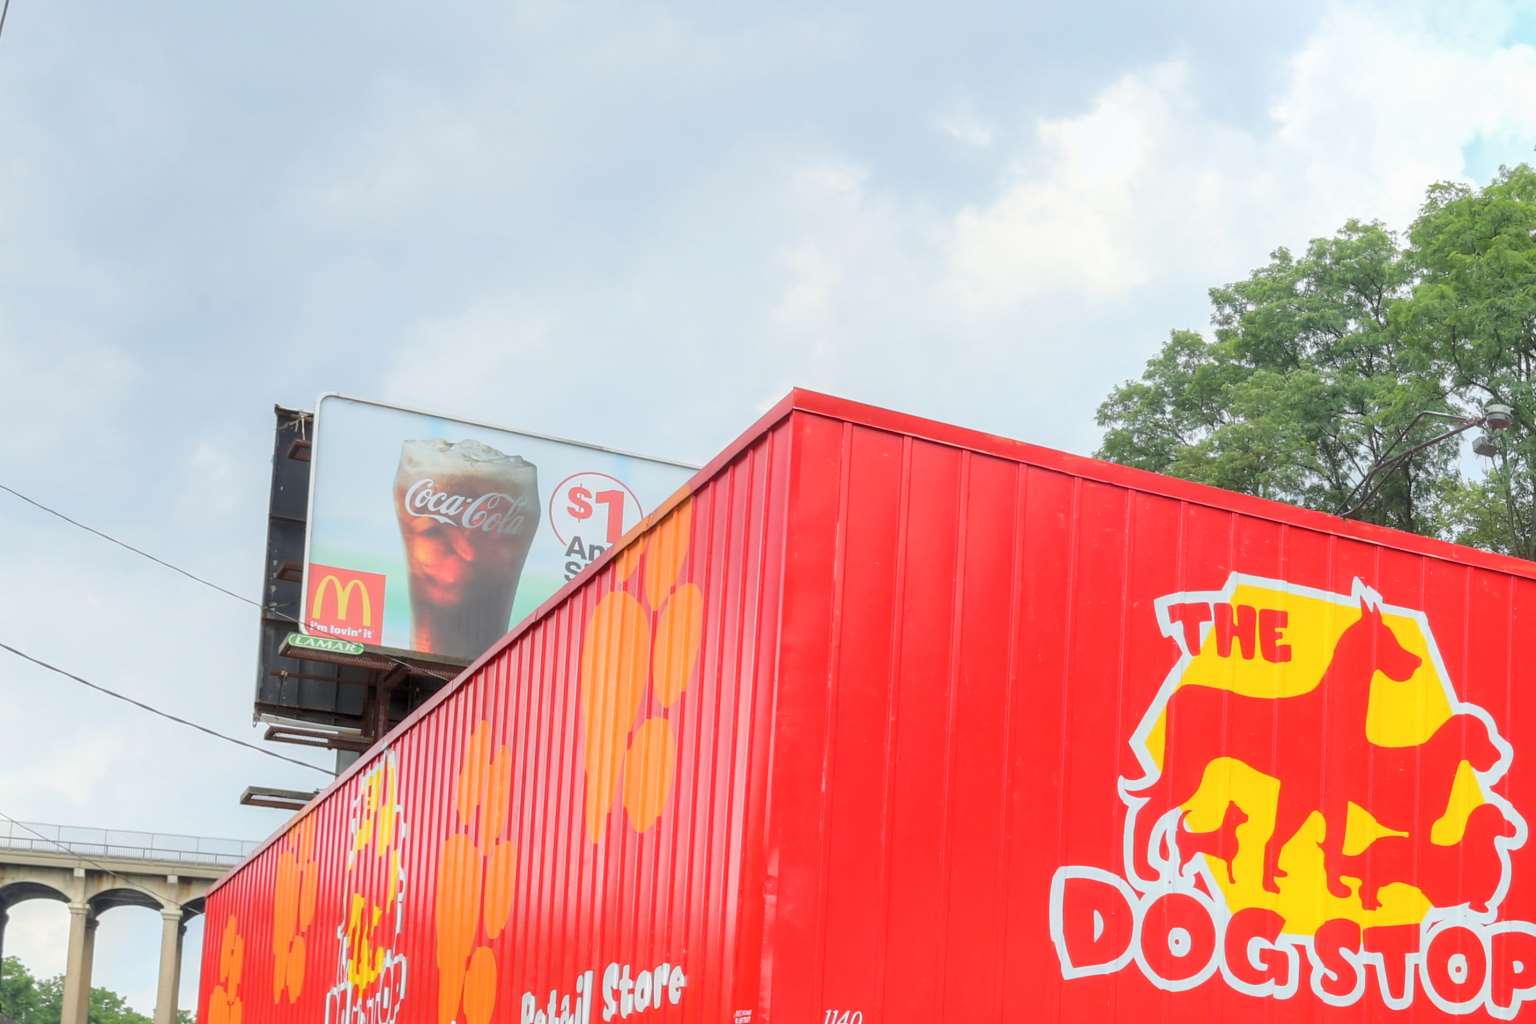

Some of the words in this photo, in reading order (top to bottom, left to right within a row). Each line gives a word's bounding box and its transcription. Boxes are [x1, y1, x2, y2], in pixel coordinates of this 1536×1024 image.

[404, 478, 527, 534] Coca-Cola
[566, 483, 625, 545] $1
[294, 634, 361, 653] LAMAR
[1168, 601, 1292, 663] THE
[602, 962, 687, 1022] Store
